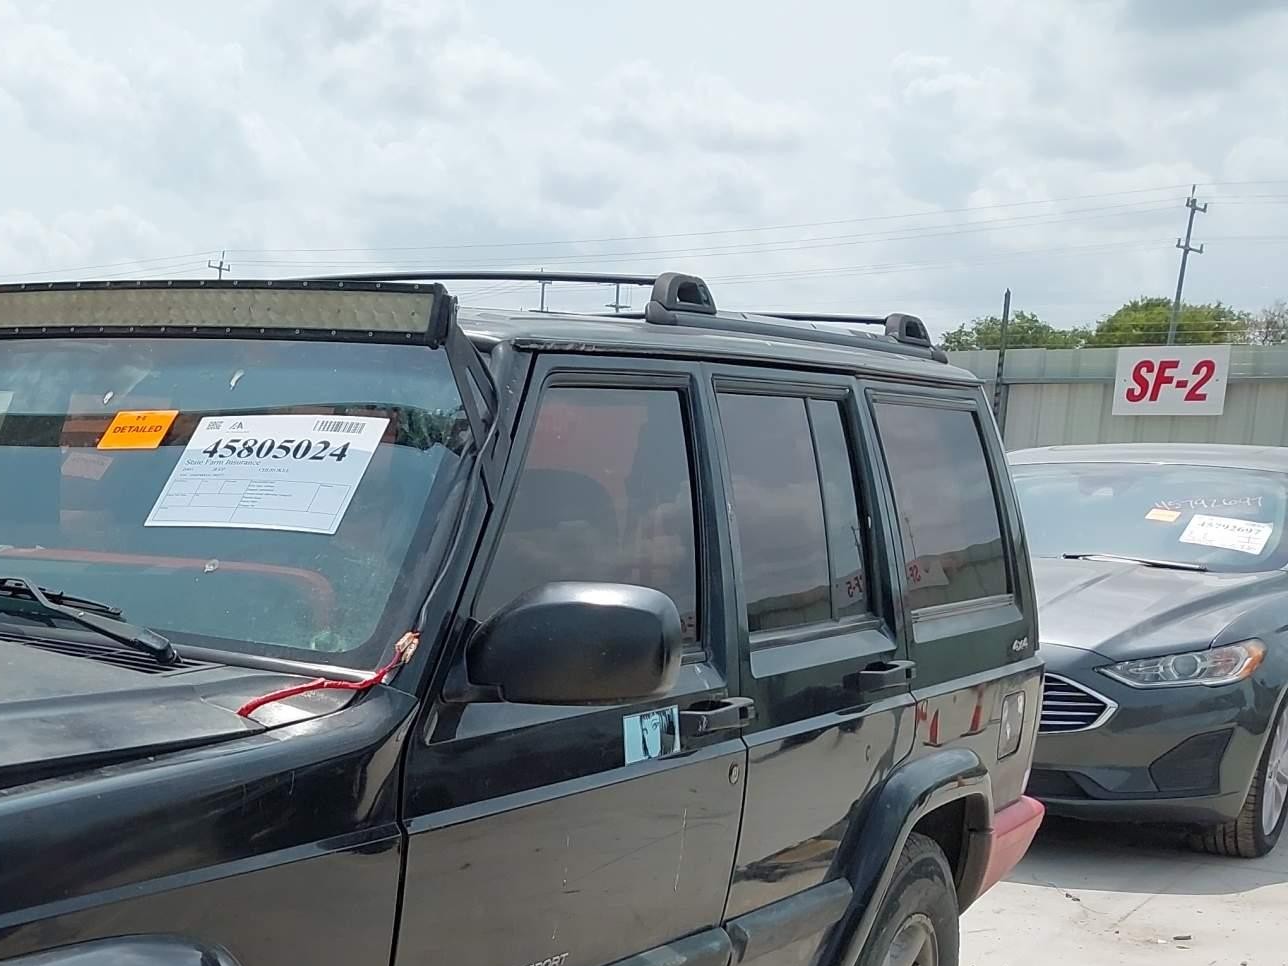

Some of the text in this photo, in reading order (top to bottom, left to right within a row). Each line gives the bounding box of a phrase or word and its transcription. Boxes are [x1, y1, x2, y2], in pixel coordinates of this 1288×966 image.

[1125, 359, 1216, 402] SF-2
[112, 425, 163, 433] DETAILED
[202, 438, 351, 462] 45805024
